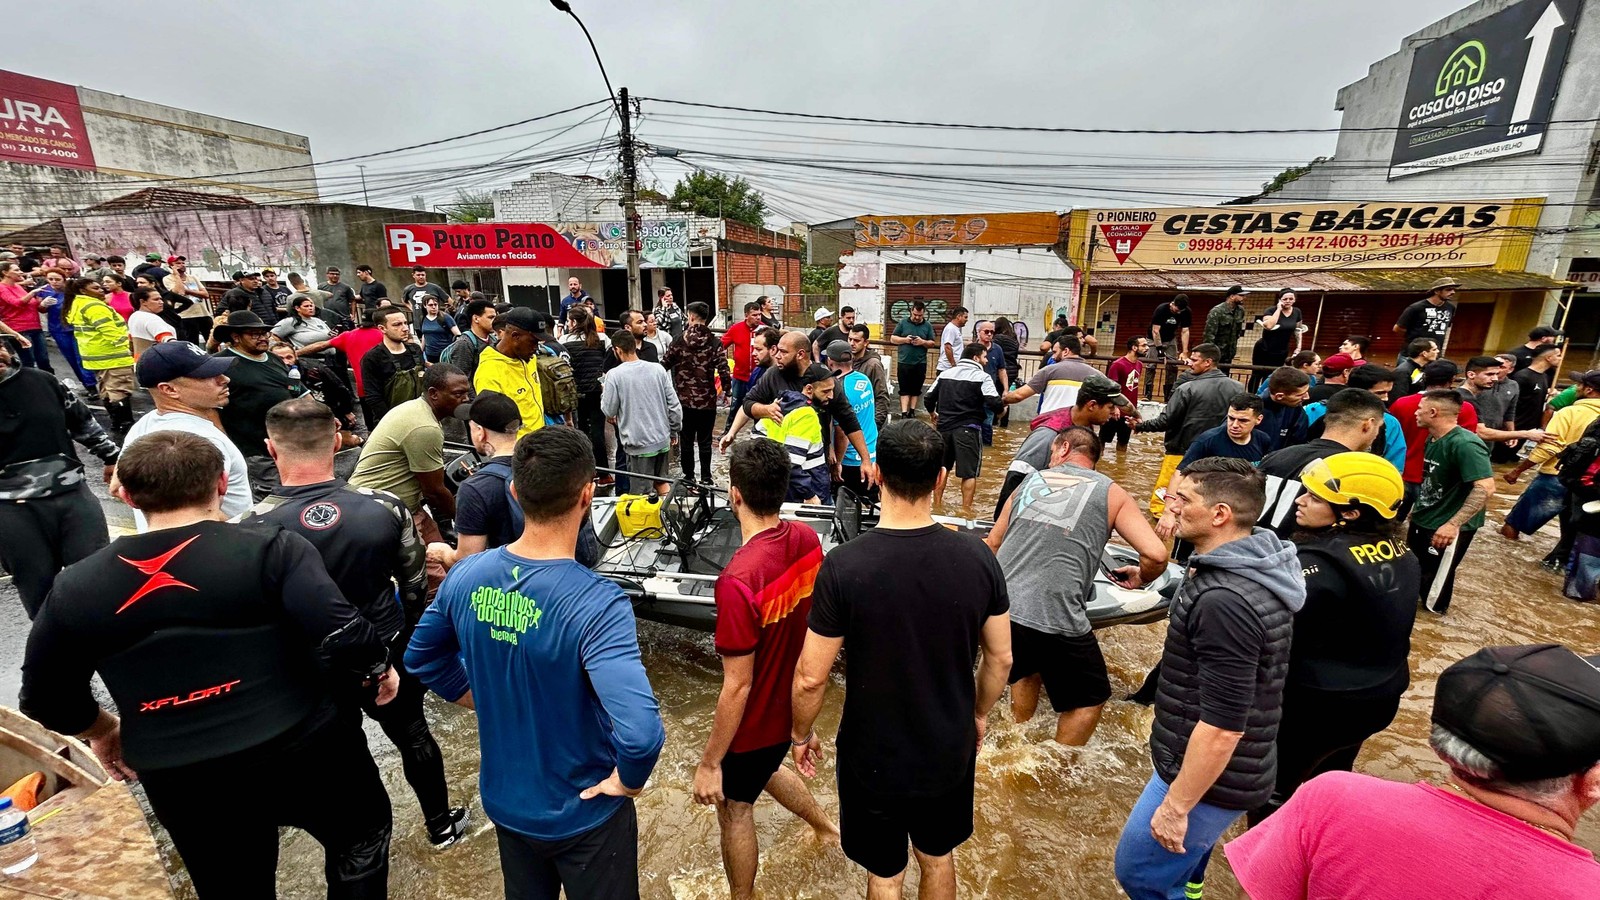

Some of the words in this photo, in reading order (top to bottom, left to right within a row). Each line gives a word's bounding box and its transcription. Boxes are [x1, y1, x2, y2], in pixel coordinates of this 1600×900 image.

[1409, 97, 1444, 120] casa
[1445, 90, 1466, 109] do
[1454, 107, 1465, 115] fica
[1465, 103, 1479, 111] mais
[1480, 96, 1501, 107] barato
[5, 133, 39, 144] MERCADO
[50, 140, 77, 150] CANOAS
[1474, 145, 1500, 157] MATHIAS
[1500, 141, 1523, 151] VELHO
[19, 144, 79, 158] 2102.4000
[1097, 212, 1104, 222] O
[1107, 211, 1157, 222] PIONEIRO
[1163, 212, 1303, 235] CESTAS
[1308, 203, 1502, 232] BÁSICAS
[433, 229, 487, 250] Puro
[495, 229, 555, 249] Pano
[647, 241, 683, 249] Tecidos
[1188, 237, 1274, 251] 99984.7344
[509, 252, 536, 260] Tecidos
[1172, 250, 1467, 266] www.pioneirocestasbasicas.com.br
[140, 679, 241, 712] XFLOAT
